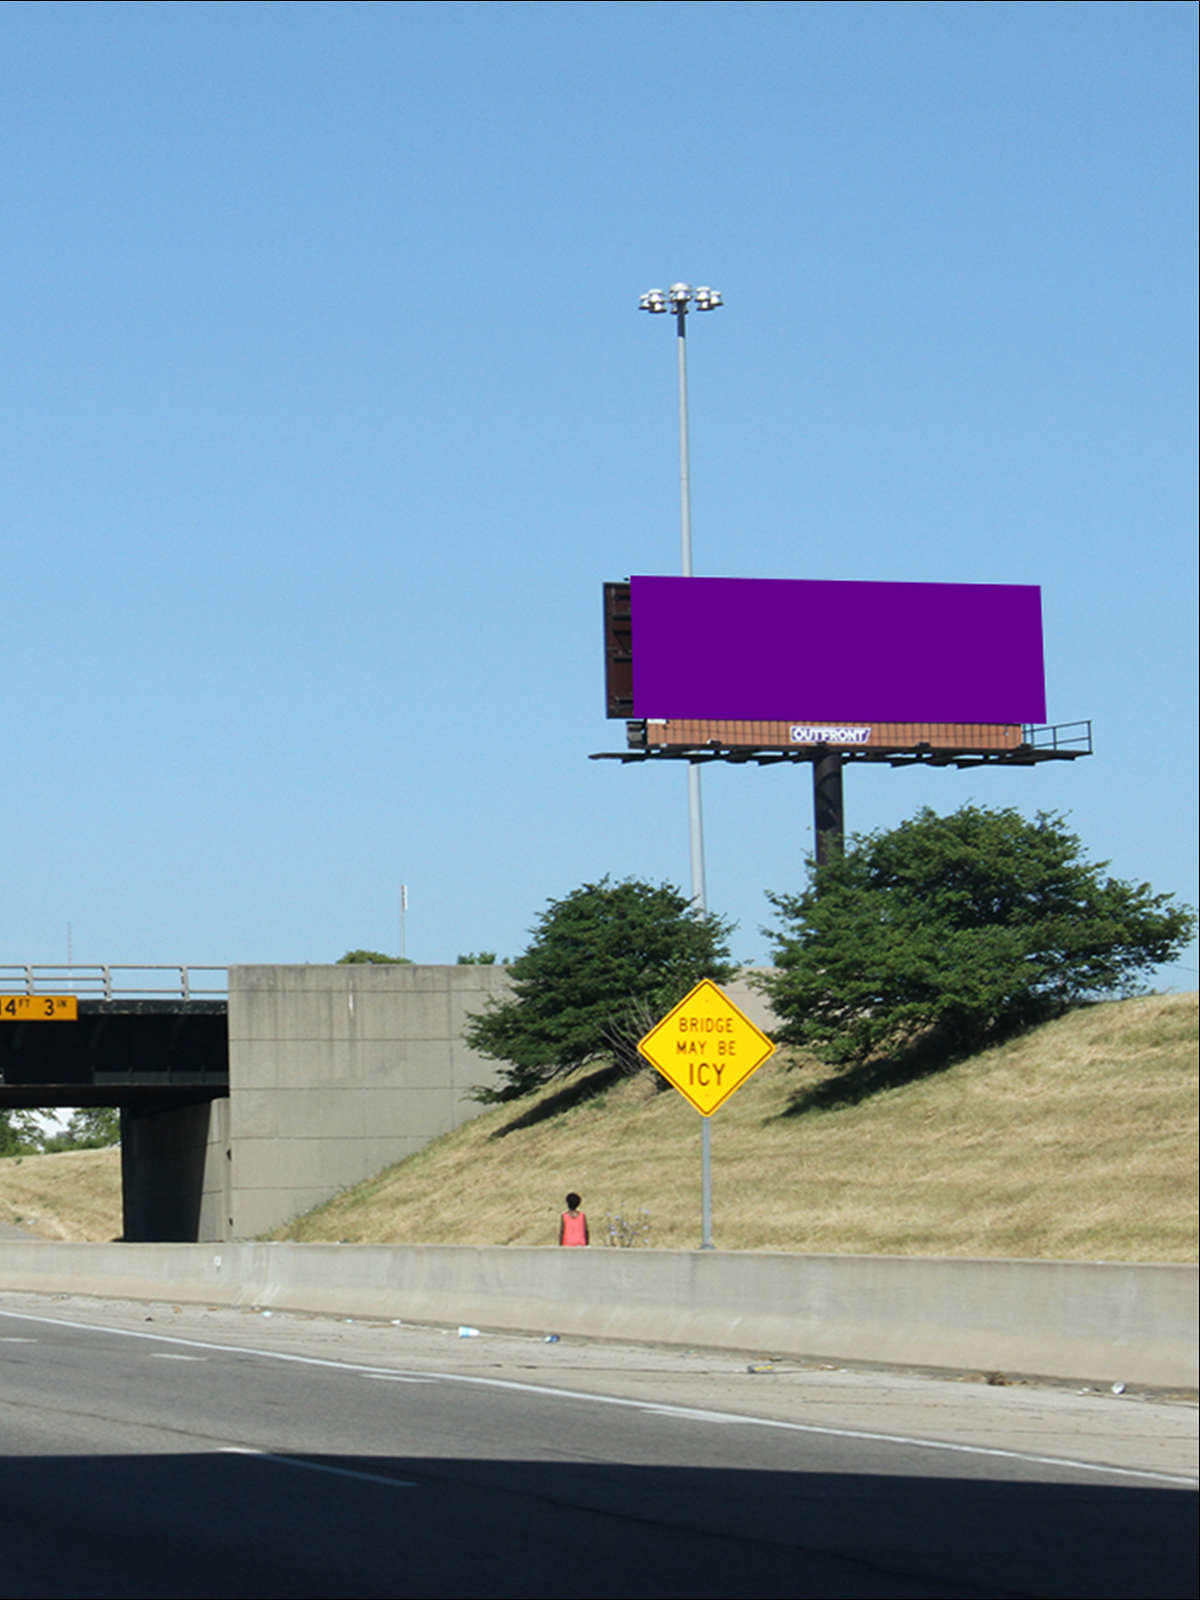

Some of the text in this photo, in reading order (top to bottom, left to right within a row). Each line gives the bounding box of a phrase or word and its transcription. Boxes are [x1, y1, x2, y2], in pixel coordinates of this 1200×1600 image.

[793, 727, 866, 741] OUTFRONT
[19, 998, 30, 1007] FT
[44, 999, 54, 1016] 3
[57, 999, 67, 1007] IN
[679, 1017, 733, 1033] BRIDGE
[676, 1040, 736, 1056] MAY BE
[689, 1062, 725, 1086] ICY
